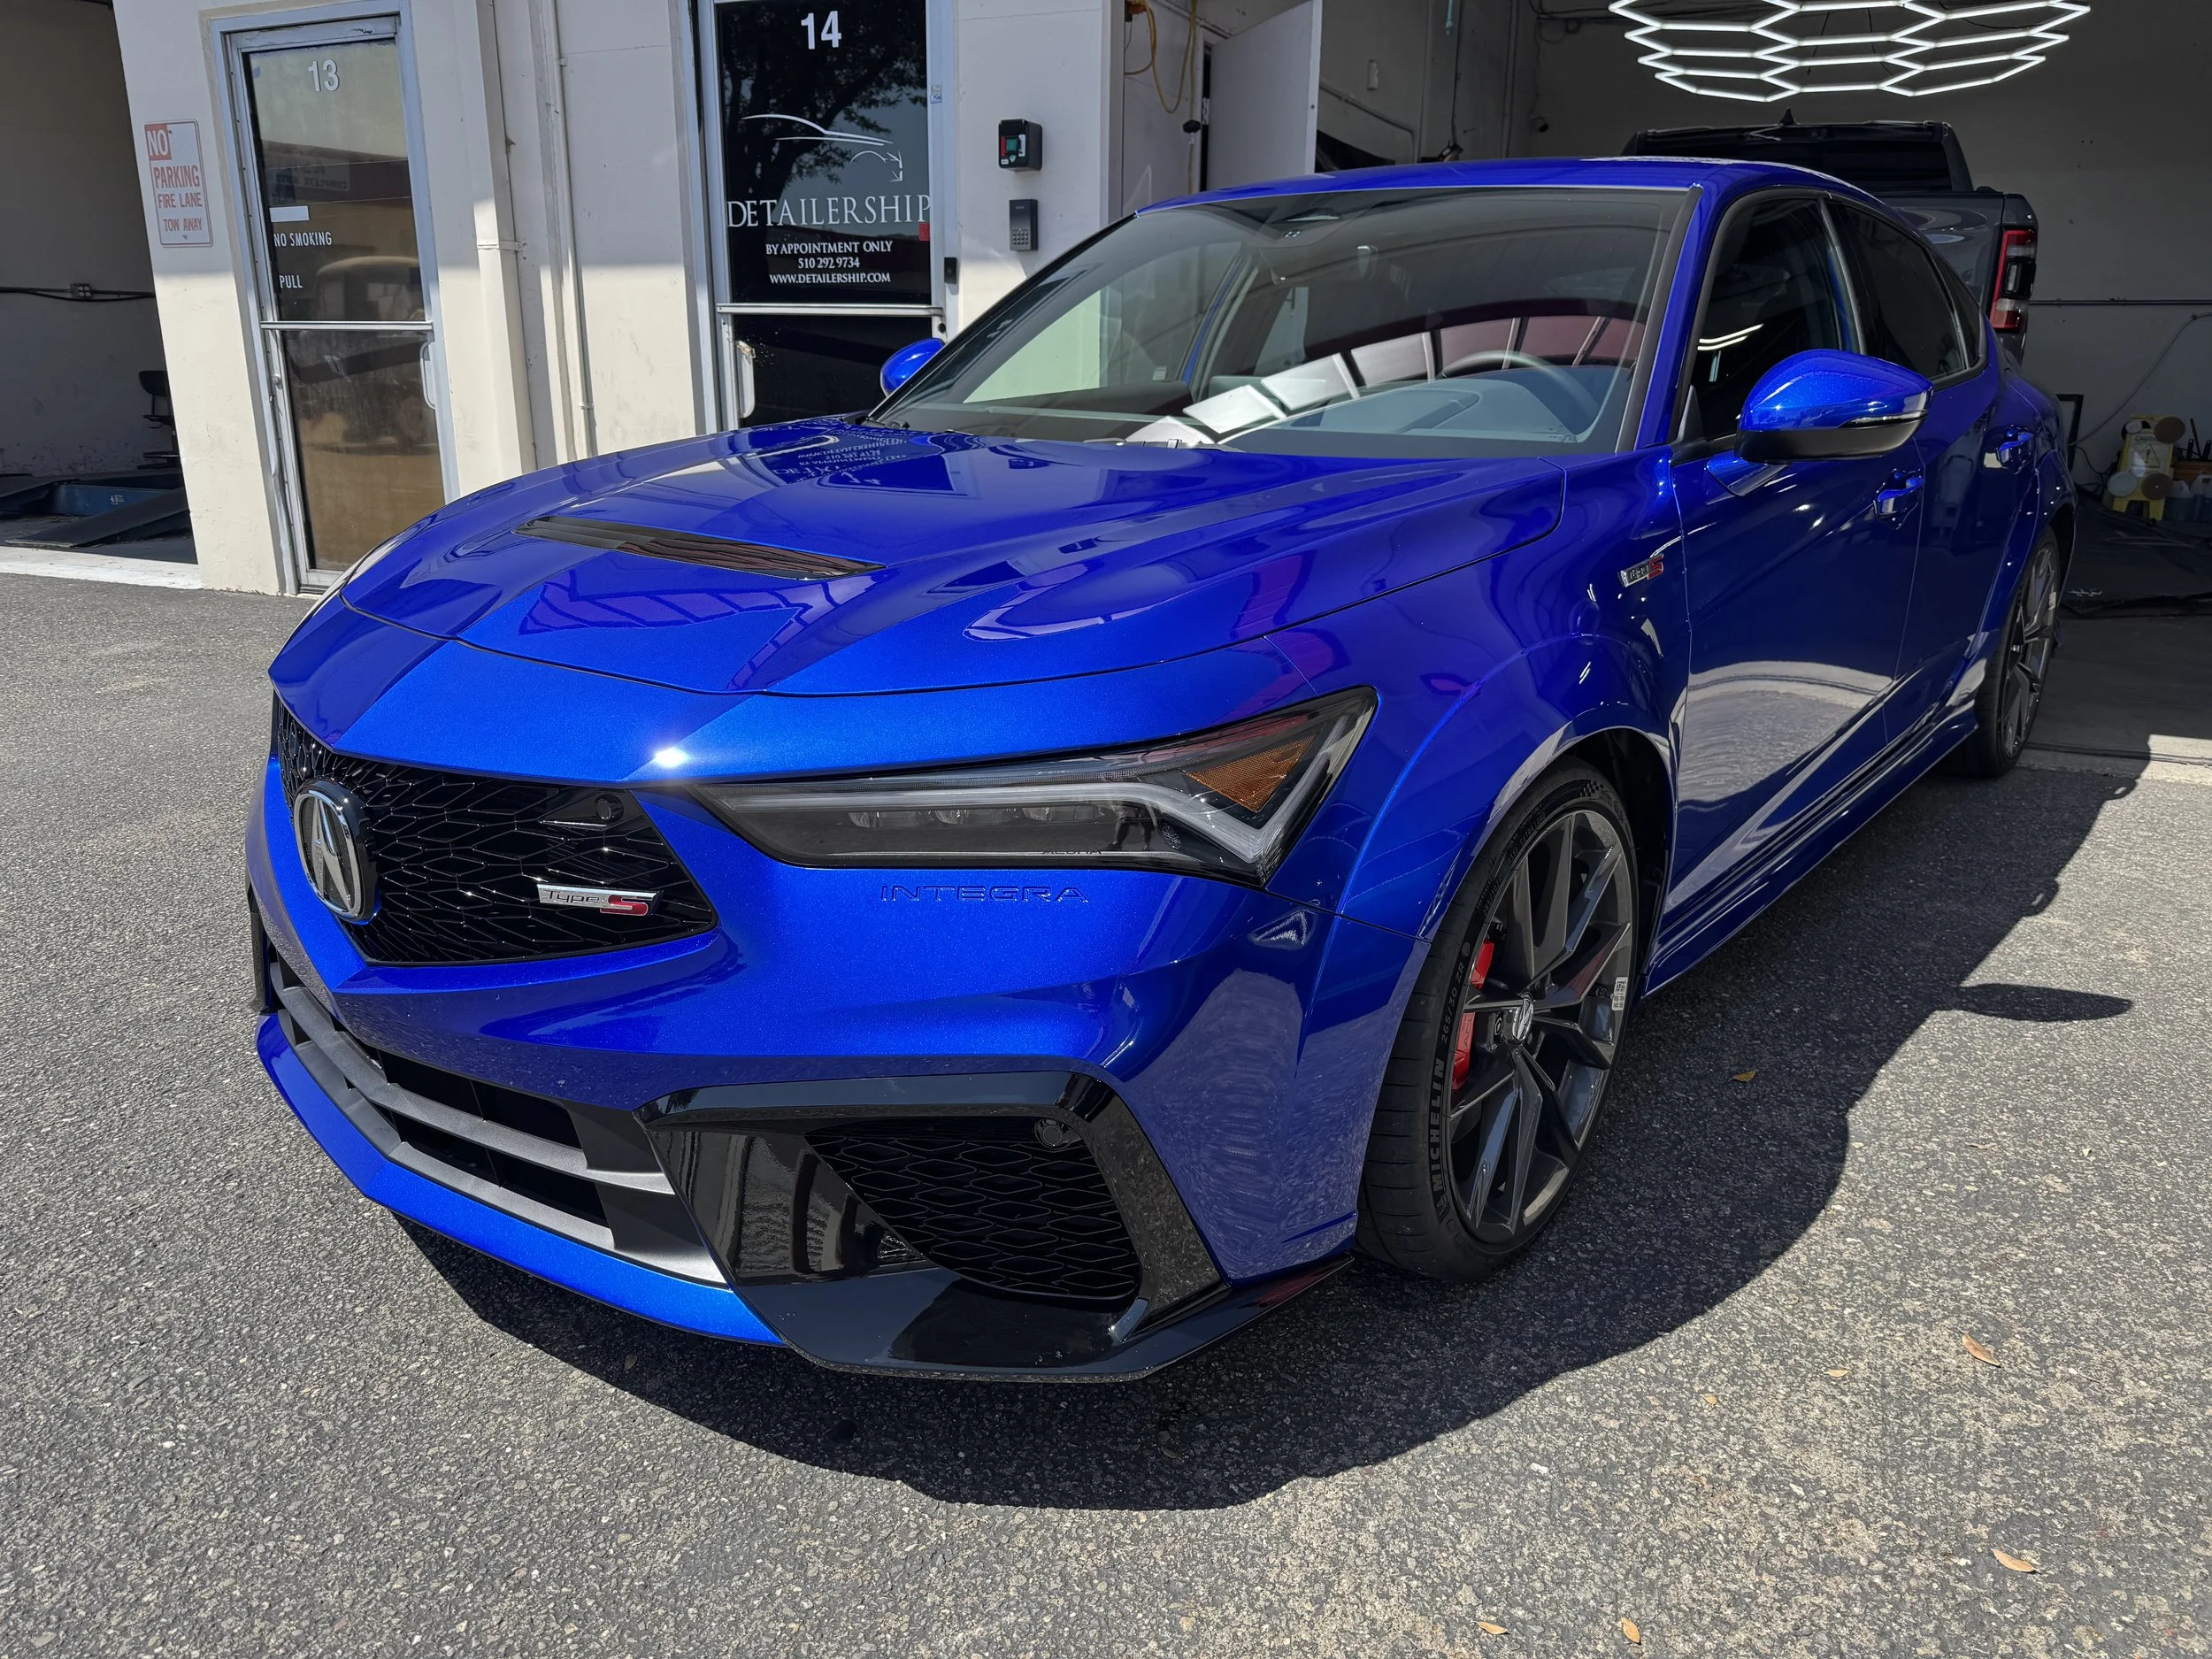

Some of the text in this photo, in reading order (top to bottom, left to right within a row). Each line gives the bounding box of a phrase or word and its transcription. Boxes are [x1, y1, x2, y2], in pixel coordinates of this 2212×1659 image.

[801, 11, 842, 50] 14
[308, 59, 340, 92] 13
[147, 129, 168, 157] NO
[153, 165, 200, 188] PARKING
[157, 192, 203, 208] FIRE LANE
[727, 195, 930, 227] DETAILERSHIP
[163, 218, 203, 232] TOW AWAY
[273, 231, 333, 247] NO SMOKING
[765, 241, 893, 255] BY APPOINTMENT ONLY
[798, 257, 860, 269] 510 292 9734
[279, 274, 303, 289] PULL
[769, 273, 891, 284] WWW.DETAILERSHIP.COM
[880, 885, 1088, 902] INTEGRA
[600, 895, 653, 917] S
[1441, 962, 1465, 1043] 265/30 ZR
[1430, 1057, 1445, 1193] MICHELIN
